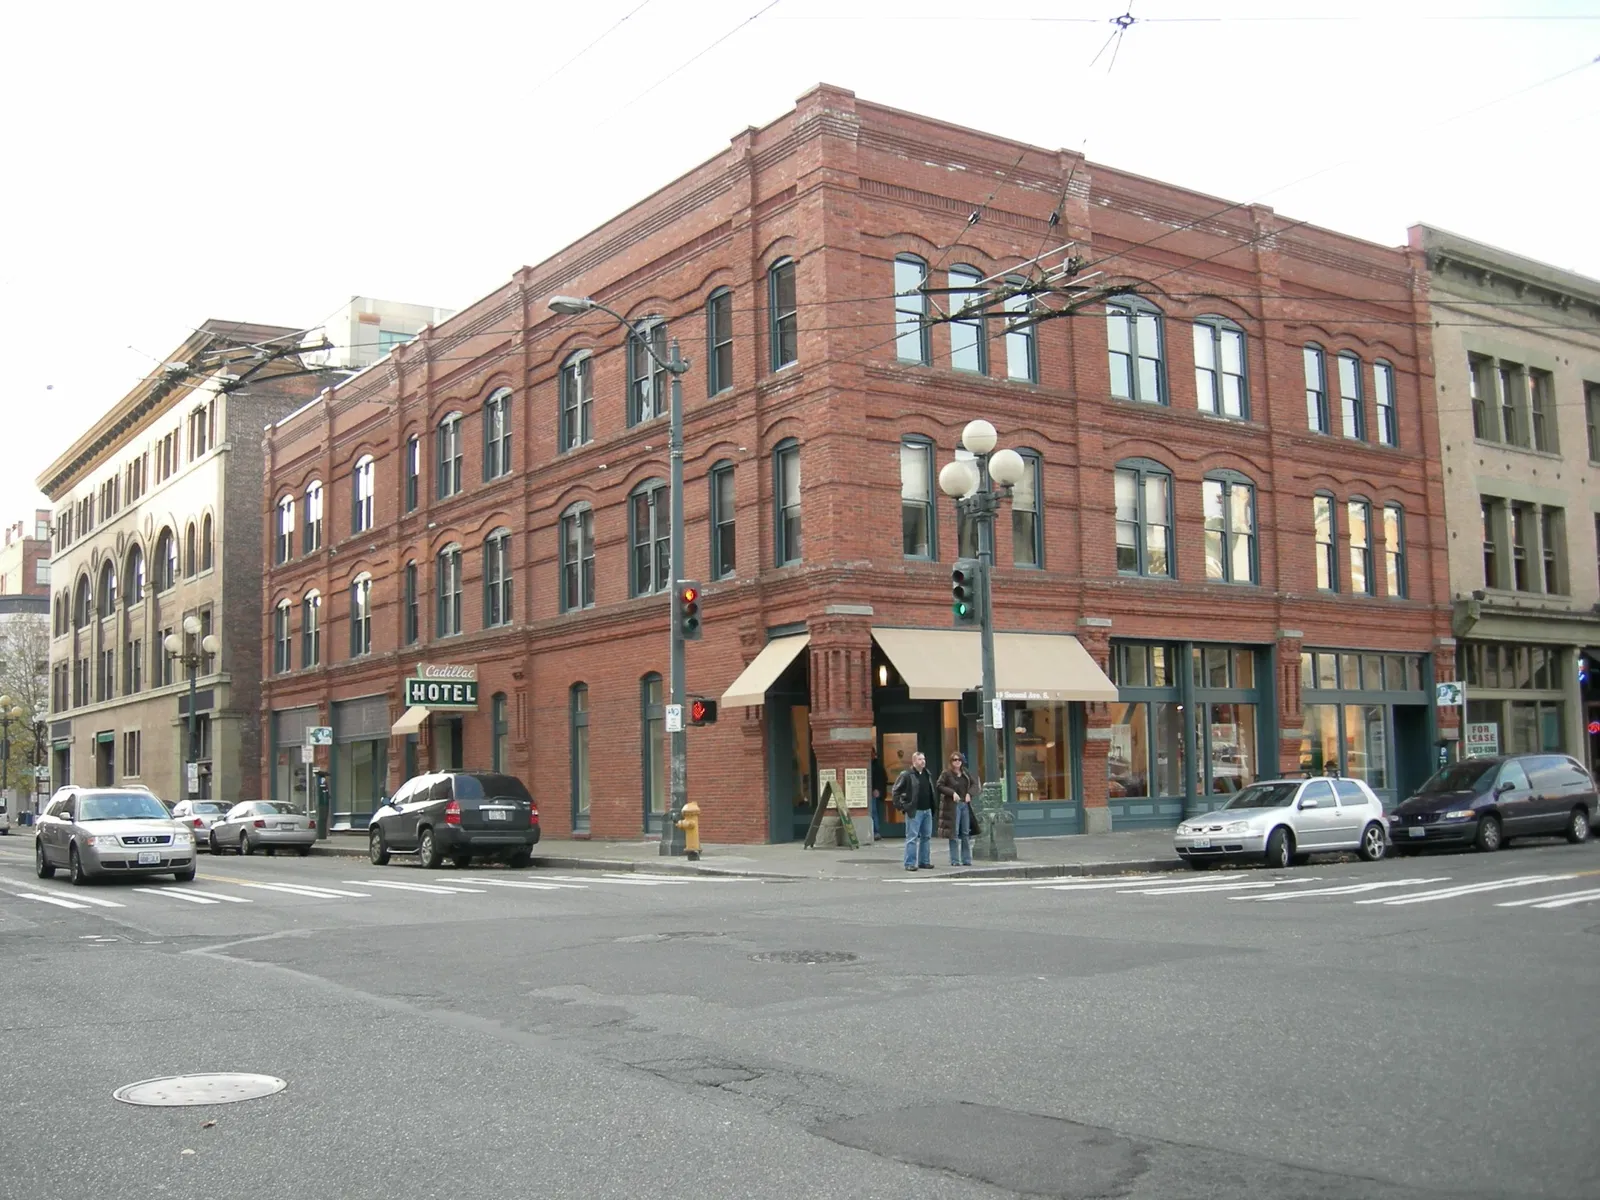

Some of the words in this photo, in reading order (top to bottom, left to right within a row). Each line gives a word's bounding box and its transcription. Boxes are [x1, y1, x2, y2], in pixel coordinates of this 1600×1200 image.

[425, 665, 474, 677] Cadillac
[412, 684, 475, 701] HOTEL
[1440, 686, 1448, 697] P
[1472, 725, 1489, 734] FOR
[1467, 734, 1496, 742] LEASE
